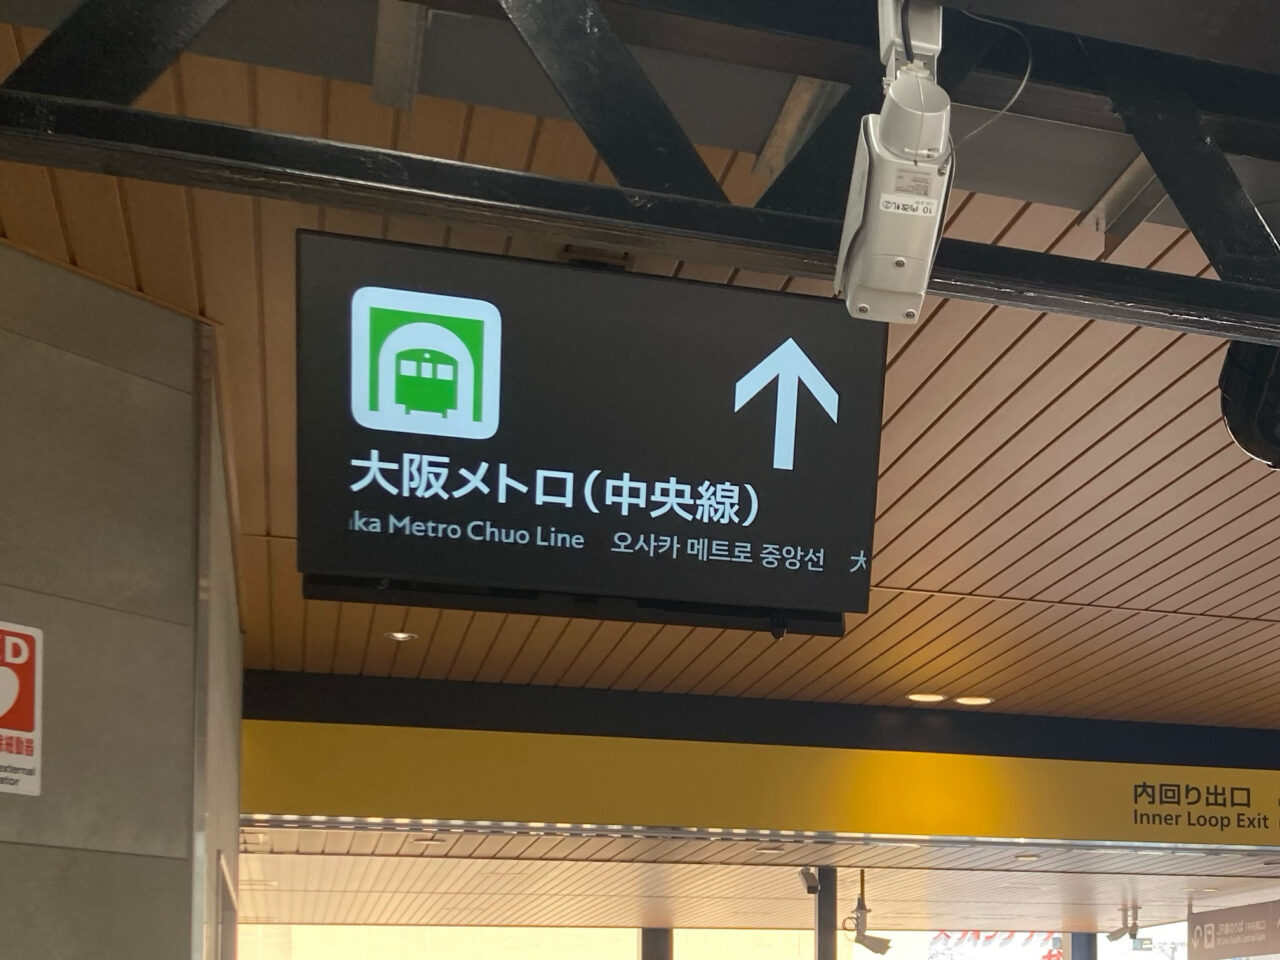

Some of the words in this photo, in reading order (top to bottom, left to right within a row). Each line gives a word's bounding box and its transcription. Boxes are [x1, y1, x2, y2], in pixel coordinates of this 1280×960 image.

[349, 450, 759, 526] 大阪メトロ(中央線)
[349, 510, 381, 532] ka
[388, 514, 461, 539] Metro
[467, 521, 530, 544] Chuo
[537, 526, 585, 549] Line
[610, 531, 680, 559] 오사카
[687, 538, 753, 563] 메트로
[760, 544, 825, 572] 중앙선
[0, 635, 29, 664] D
[1133, 781, 1251, 808] 内回り出口
[1133, 809, 1182, 826] Inner
[1187, 811, 1231, 831] Loop
[1236, 813, 1269, 829] Exit
